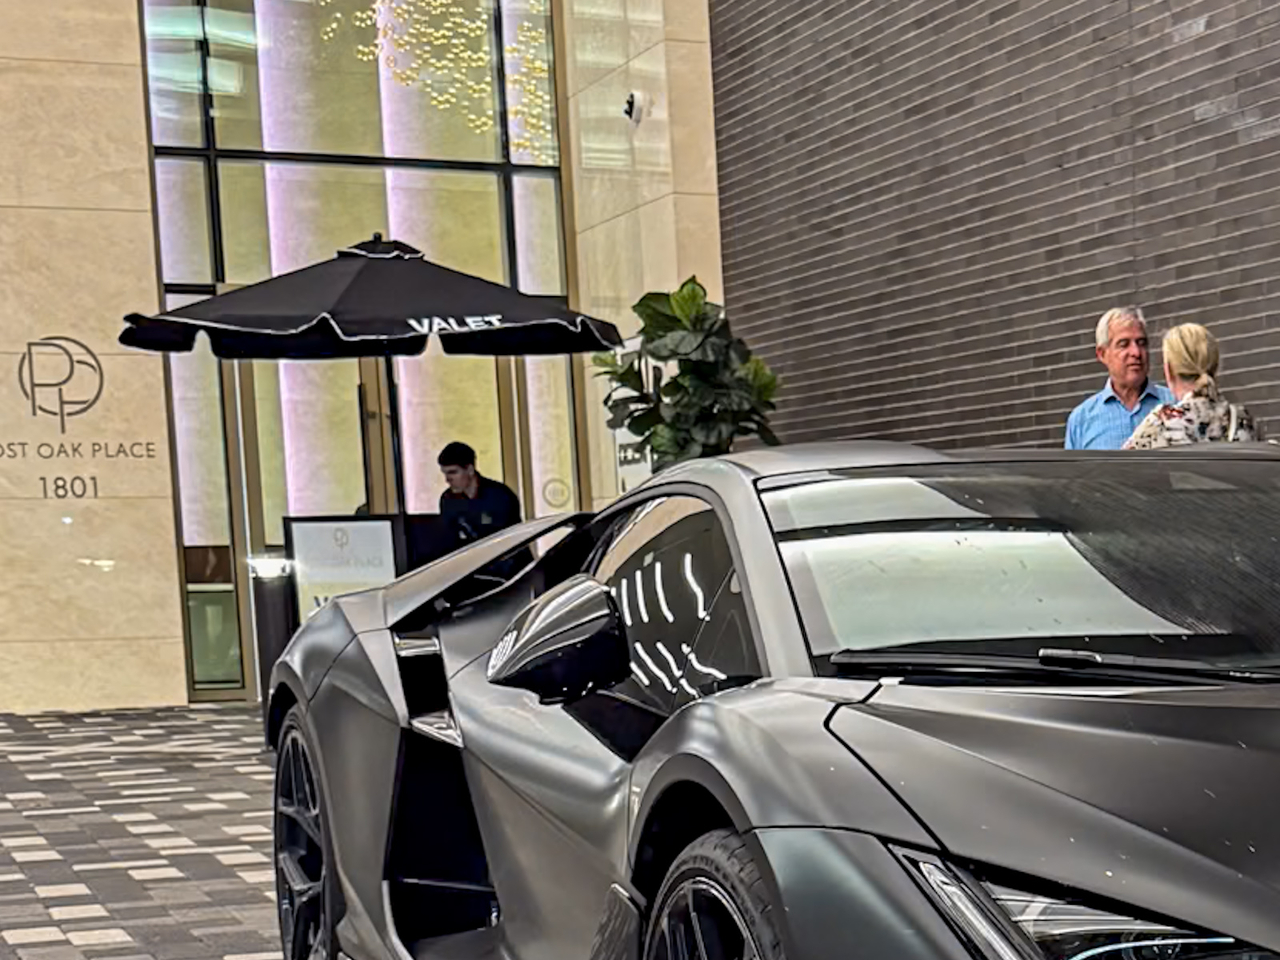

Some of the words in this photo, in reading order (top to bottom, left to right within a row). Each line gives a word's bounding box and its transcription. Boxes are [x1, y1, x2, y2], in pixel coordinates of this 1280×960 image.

[406, 313, 503, 334] VALET
[36, 442, 84, 459] OAK
[91, 442, 157, 459] PLACE
[38, 475, 99, 499] 1801
